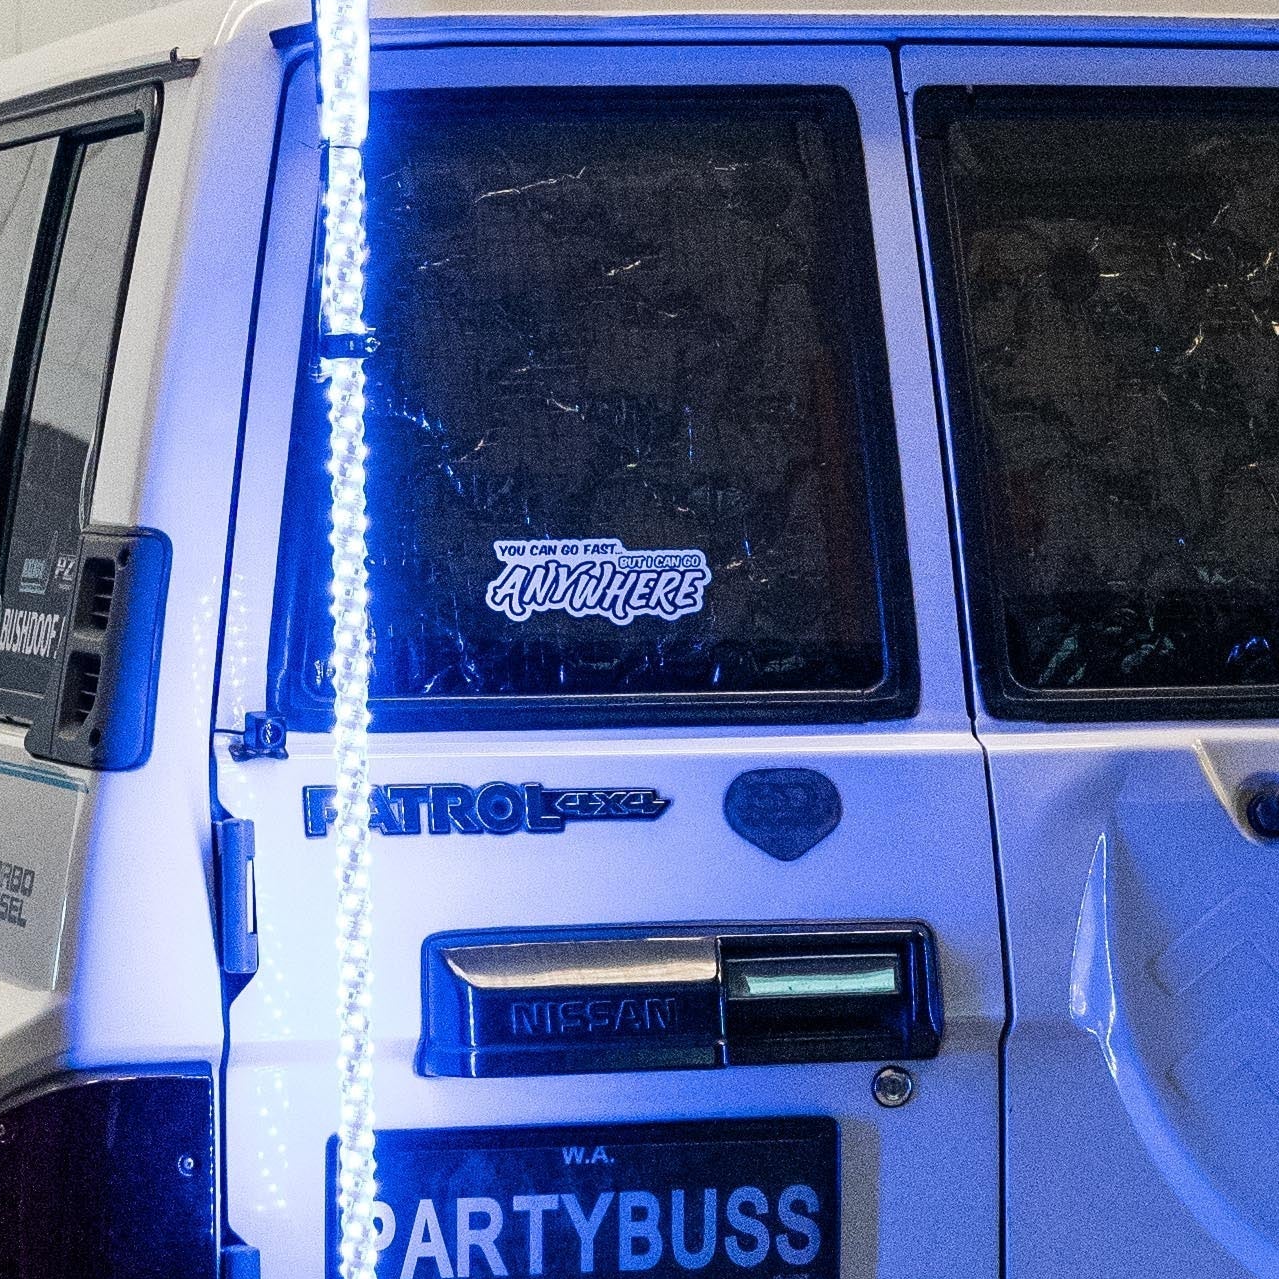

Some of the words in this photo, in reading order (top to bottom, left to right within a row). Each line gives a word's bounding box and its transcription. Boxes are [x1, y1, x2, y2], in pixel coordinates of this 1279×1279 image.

[499, 544, 526, 557] YOU
[529, 544, 557, 556] CAN
[560, 543, 579, 555] GO
[619, 555, 645, 569] BUT
[646, 555, 653, 568] I
[654, 555, 681, 568] CAN
[682, 555, 701, 568] GO
[491, 560, 705, 620] ANYWHERE
[303, 781, 565, 838] PATROL
[511, 997, 677, 1035] NISSAN
[562, 1145, 615, 1165] W.A.
